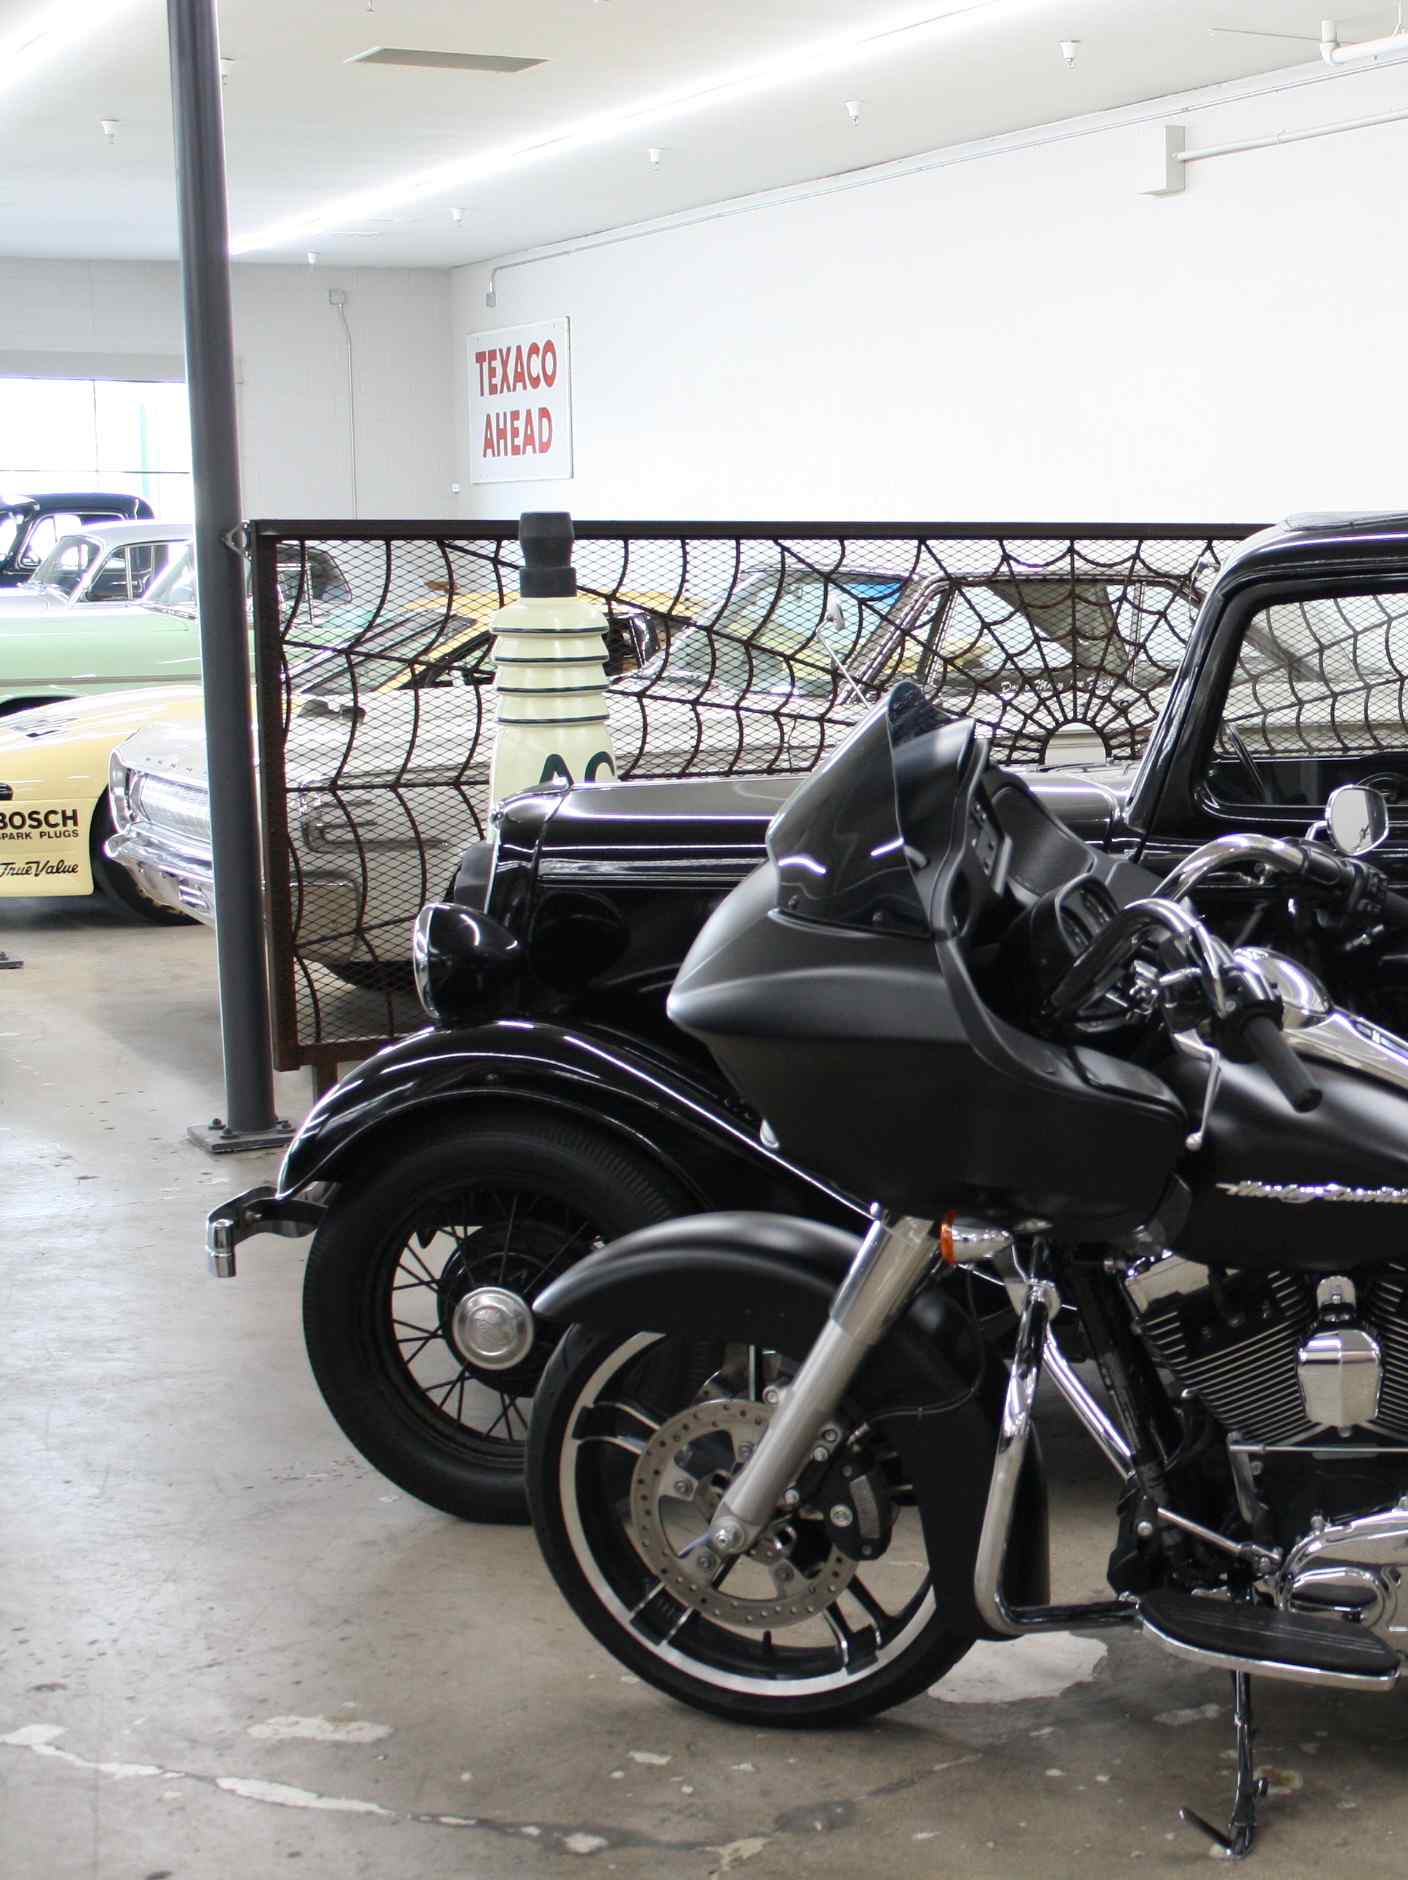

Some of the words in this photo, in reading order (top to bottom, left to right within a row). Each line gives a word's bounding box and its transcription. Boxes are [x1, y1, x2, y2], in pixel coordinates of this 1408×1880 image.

[475, 339, 558, 397] TEXACO
[483, 407, 552, 458] AHEAD
[0, 831, 33, 840] PARK
[40, 830, 79, 839] PLUGS
